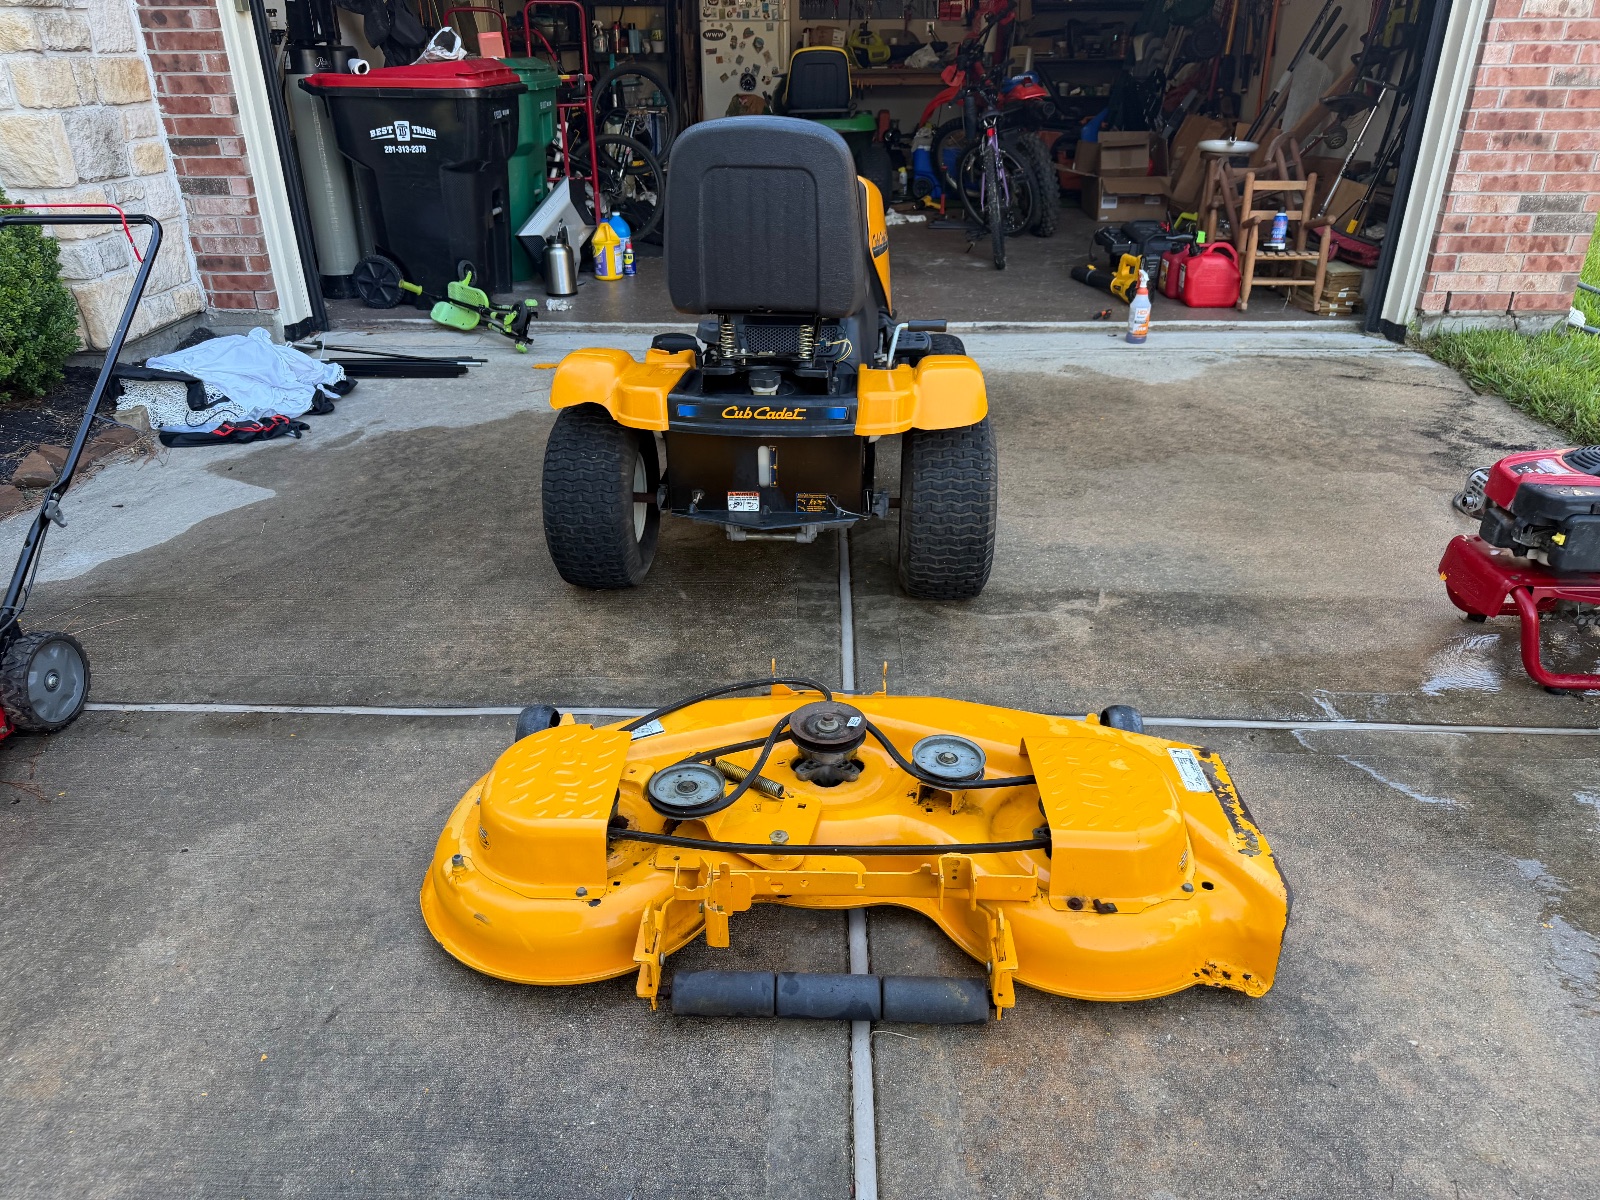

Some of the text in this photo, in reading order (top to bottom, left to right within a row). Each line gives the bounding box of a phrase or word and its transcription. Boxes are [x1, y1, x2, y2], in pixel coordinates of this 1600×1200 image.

[369, 125, 394, 138] BEST
[411, 125, 437, 138] TRASH
[721, 405, 807, 420] Cub Cadet
